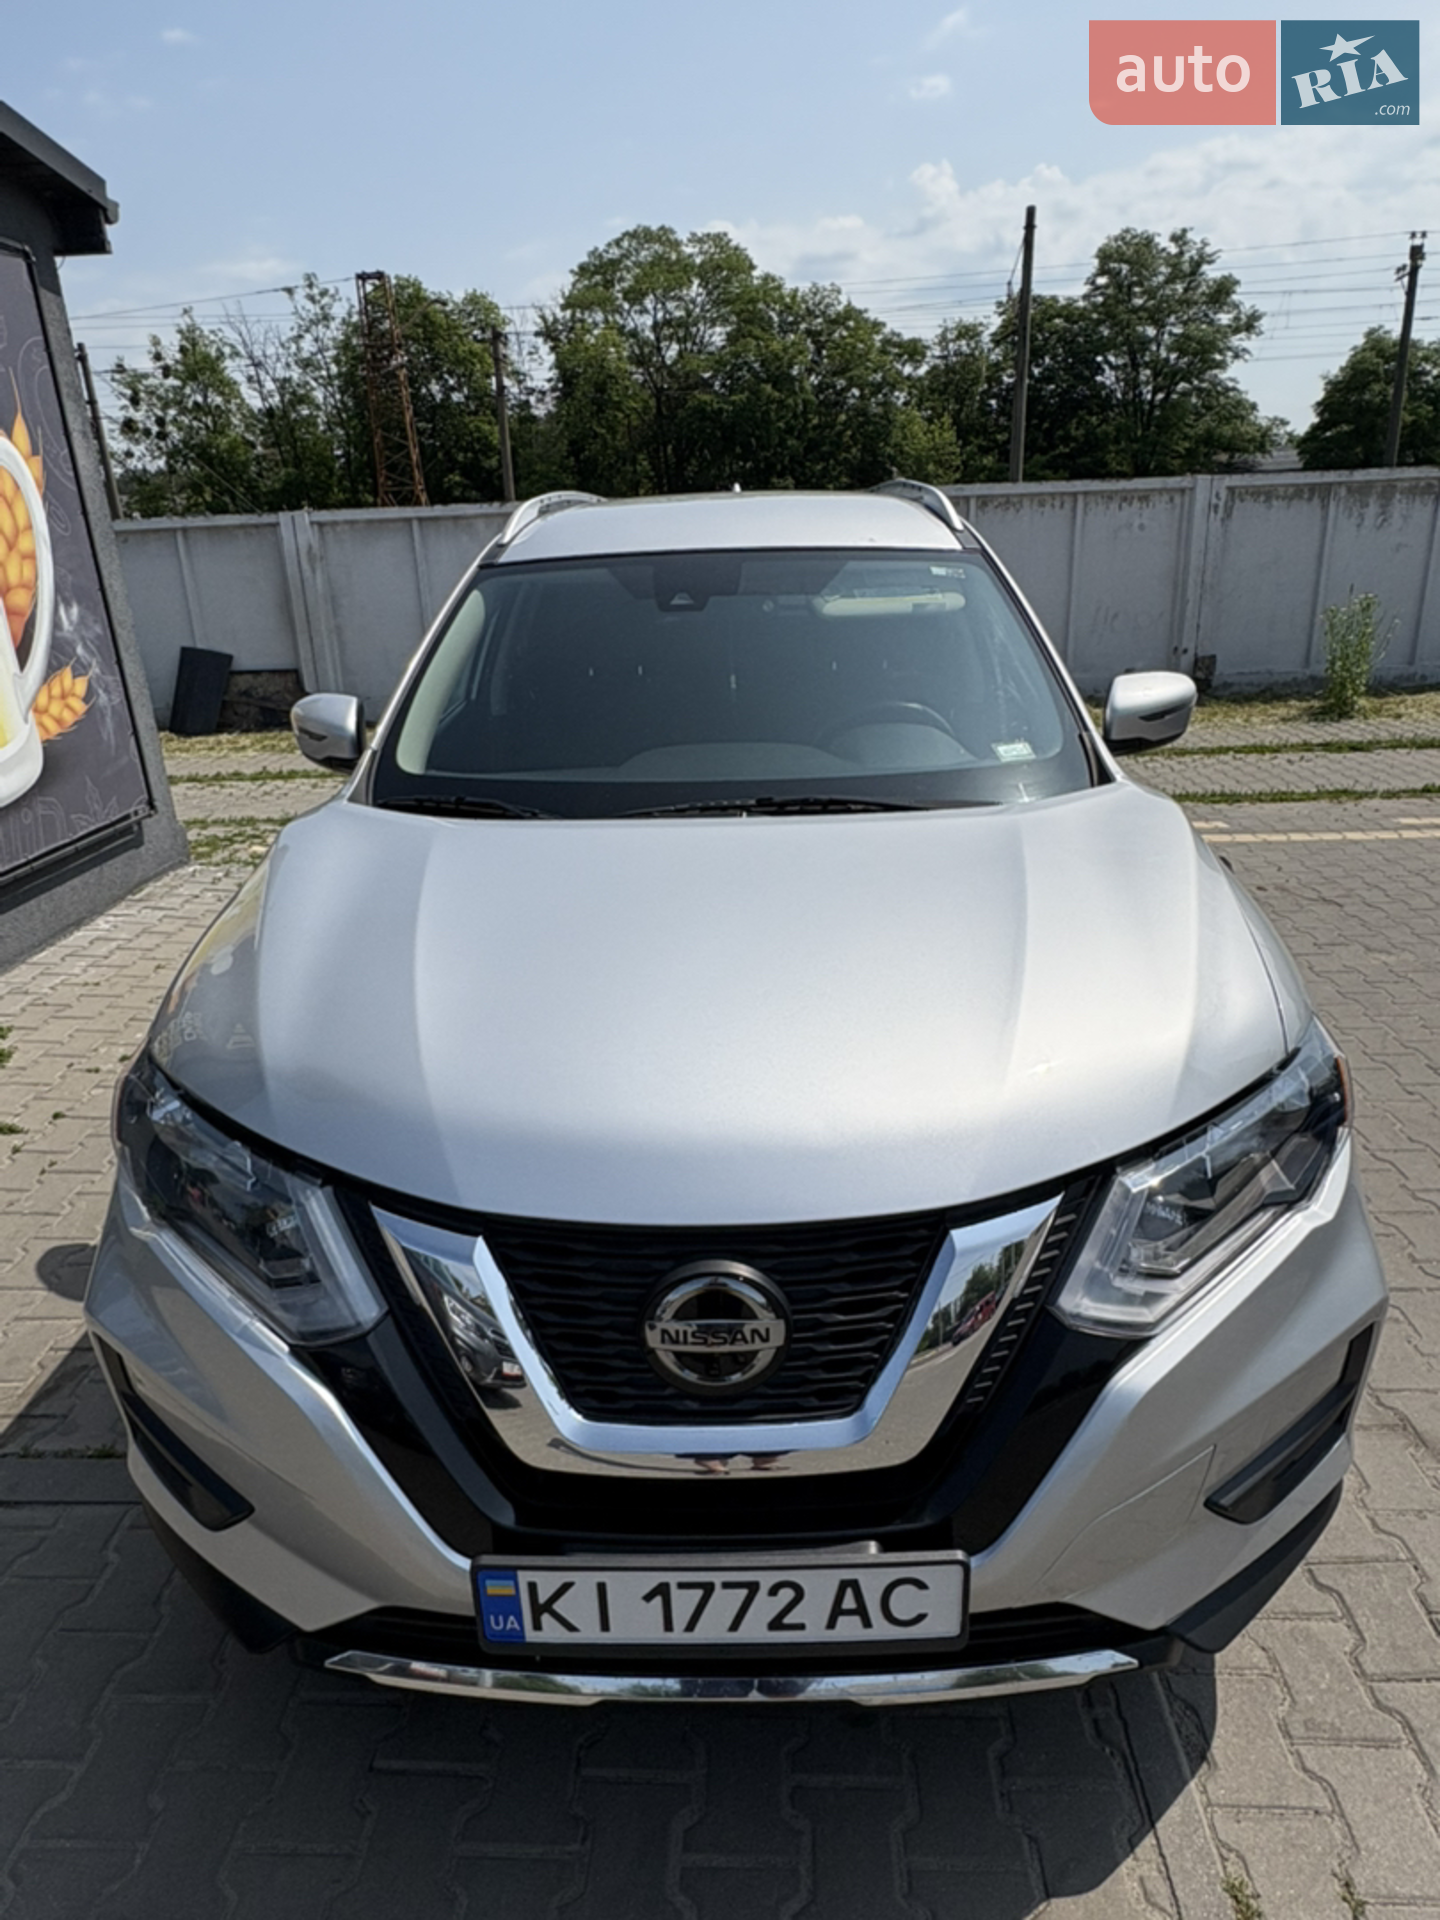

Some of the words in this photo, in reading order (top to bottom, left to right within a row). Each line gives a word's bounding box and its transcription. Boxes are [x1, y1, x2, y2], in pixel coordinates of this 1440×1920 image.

[660, 1327, 770, 1346] NISSAN
[526, 1581, 610, 1633] KI
[641, 1581, 807, 1633] 1772
[825, 1577, 930, 1630] AC
[489, 1615, 520, 1631] UA
